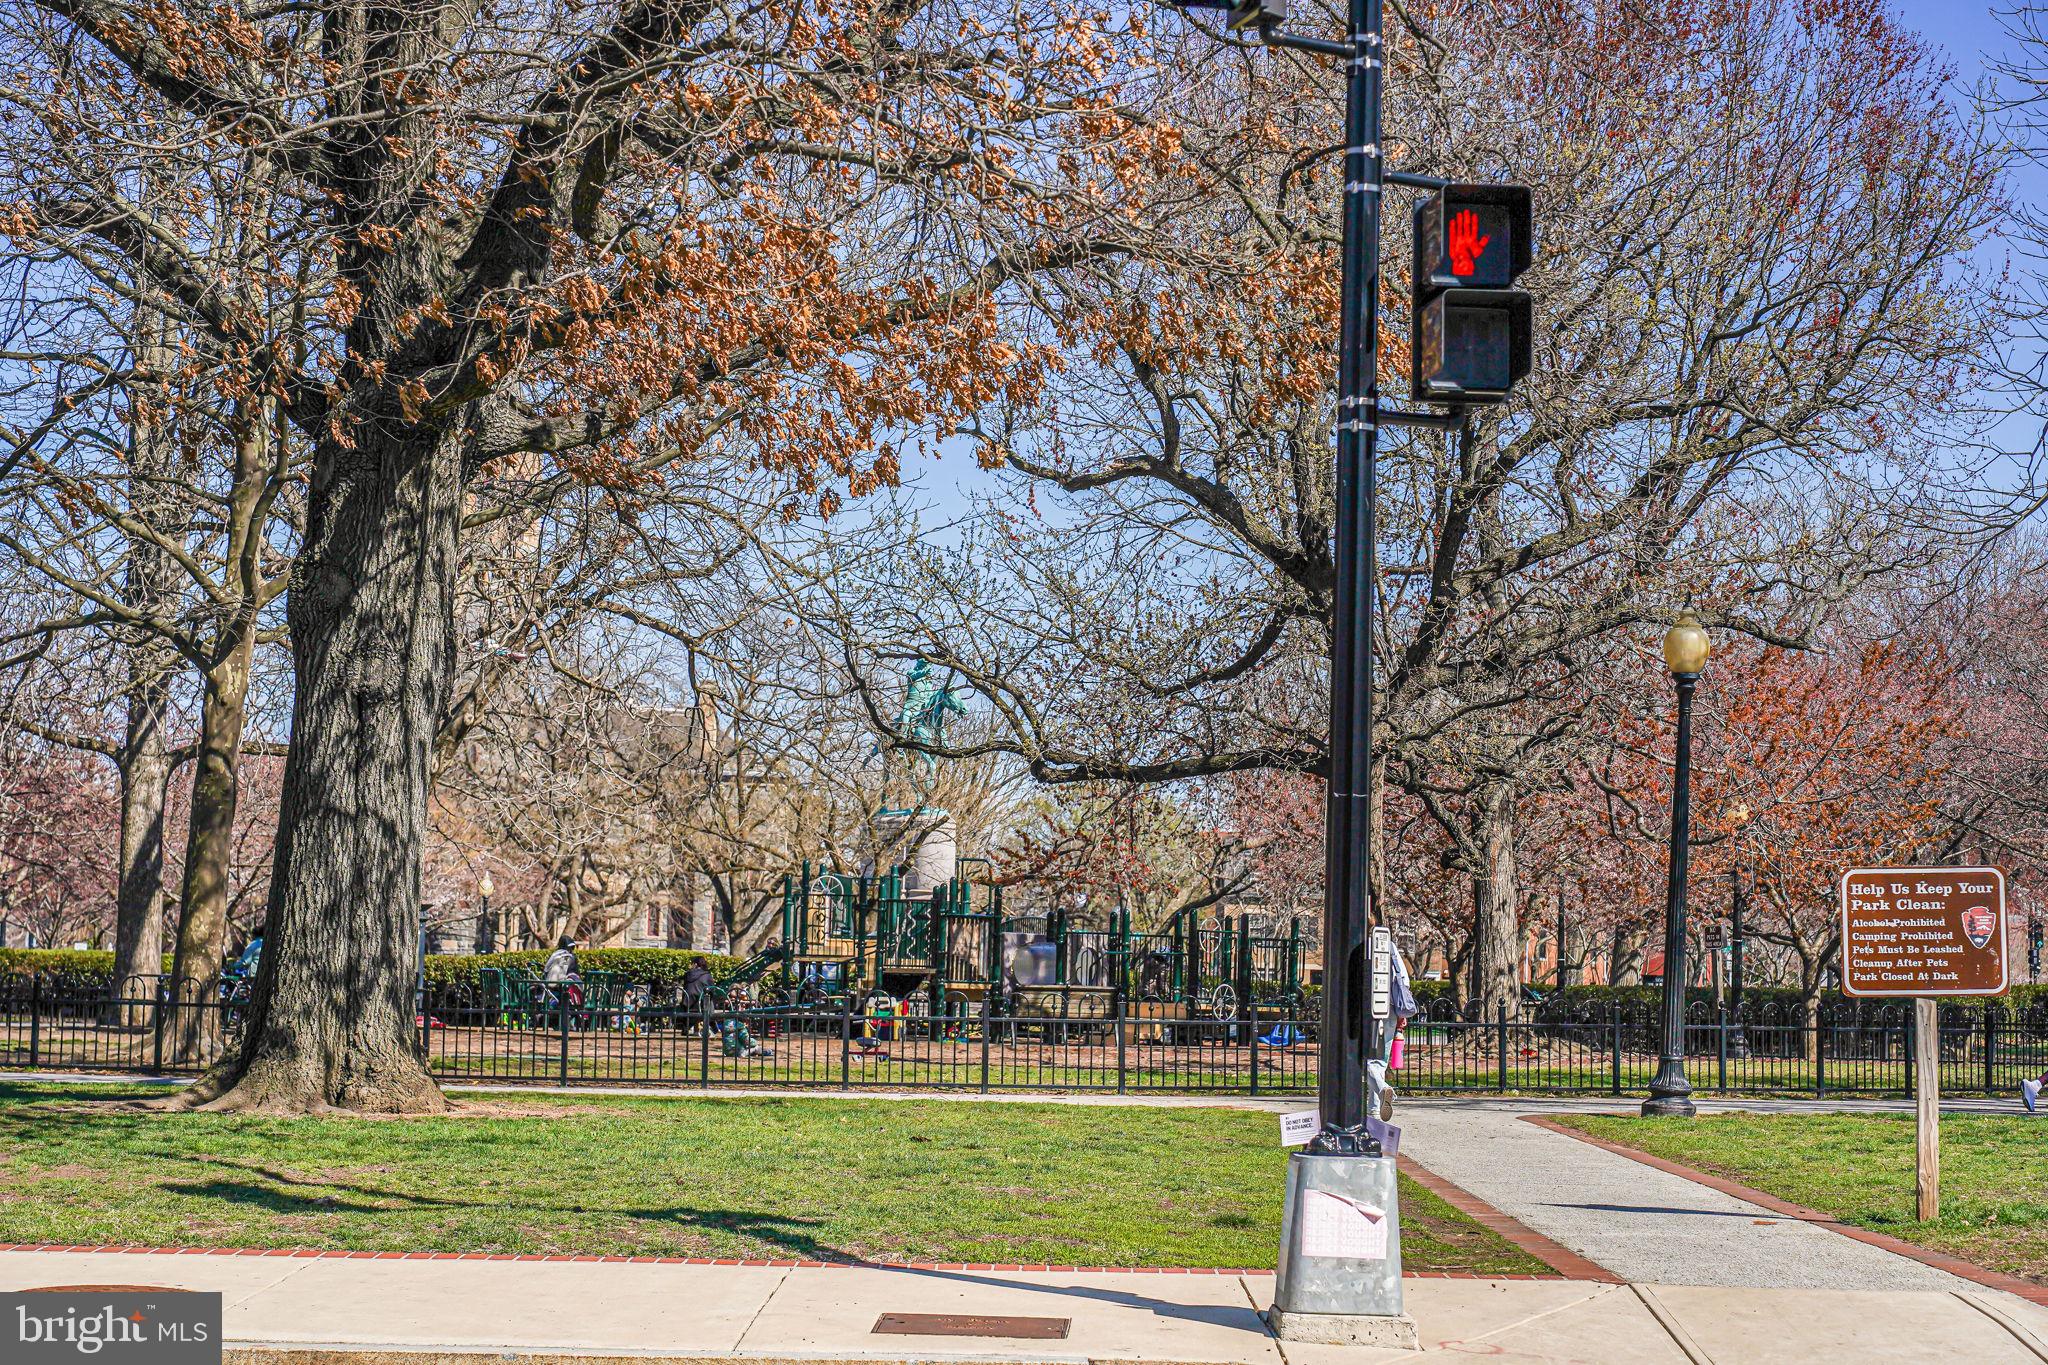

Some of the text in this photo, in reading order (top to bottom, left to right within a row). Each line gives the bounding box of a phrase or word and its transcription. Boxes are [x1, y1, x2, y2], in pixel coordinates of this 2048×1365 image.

[1850, 882, 1994, 897] Help Us Keep Your
[1851, 898, 1946, 911] Park Clean:
[1852, 918, 1946, 928] Alcohol Prohibited
[1852, 931, 1954, 943] Camping Prohibited
[1852, 945, 1964, 955] Pets Must Be Leashed
[1853, 958, 1949, 969] Cleanup After Pets
[1853, 972, 1959, 981] Park Closed At Dark
